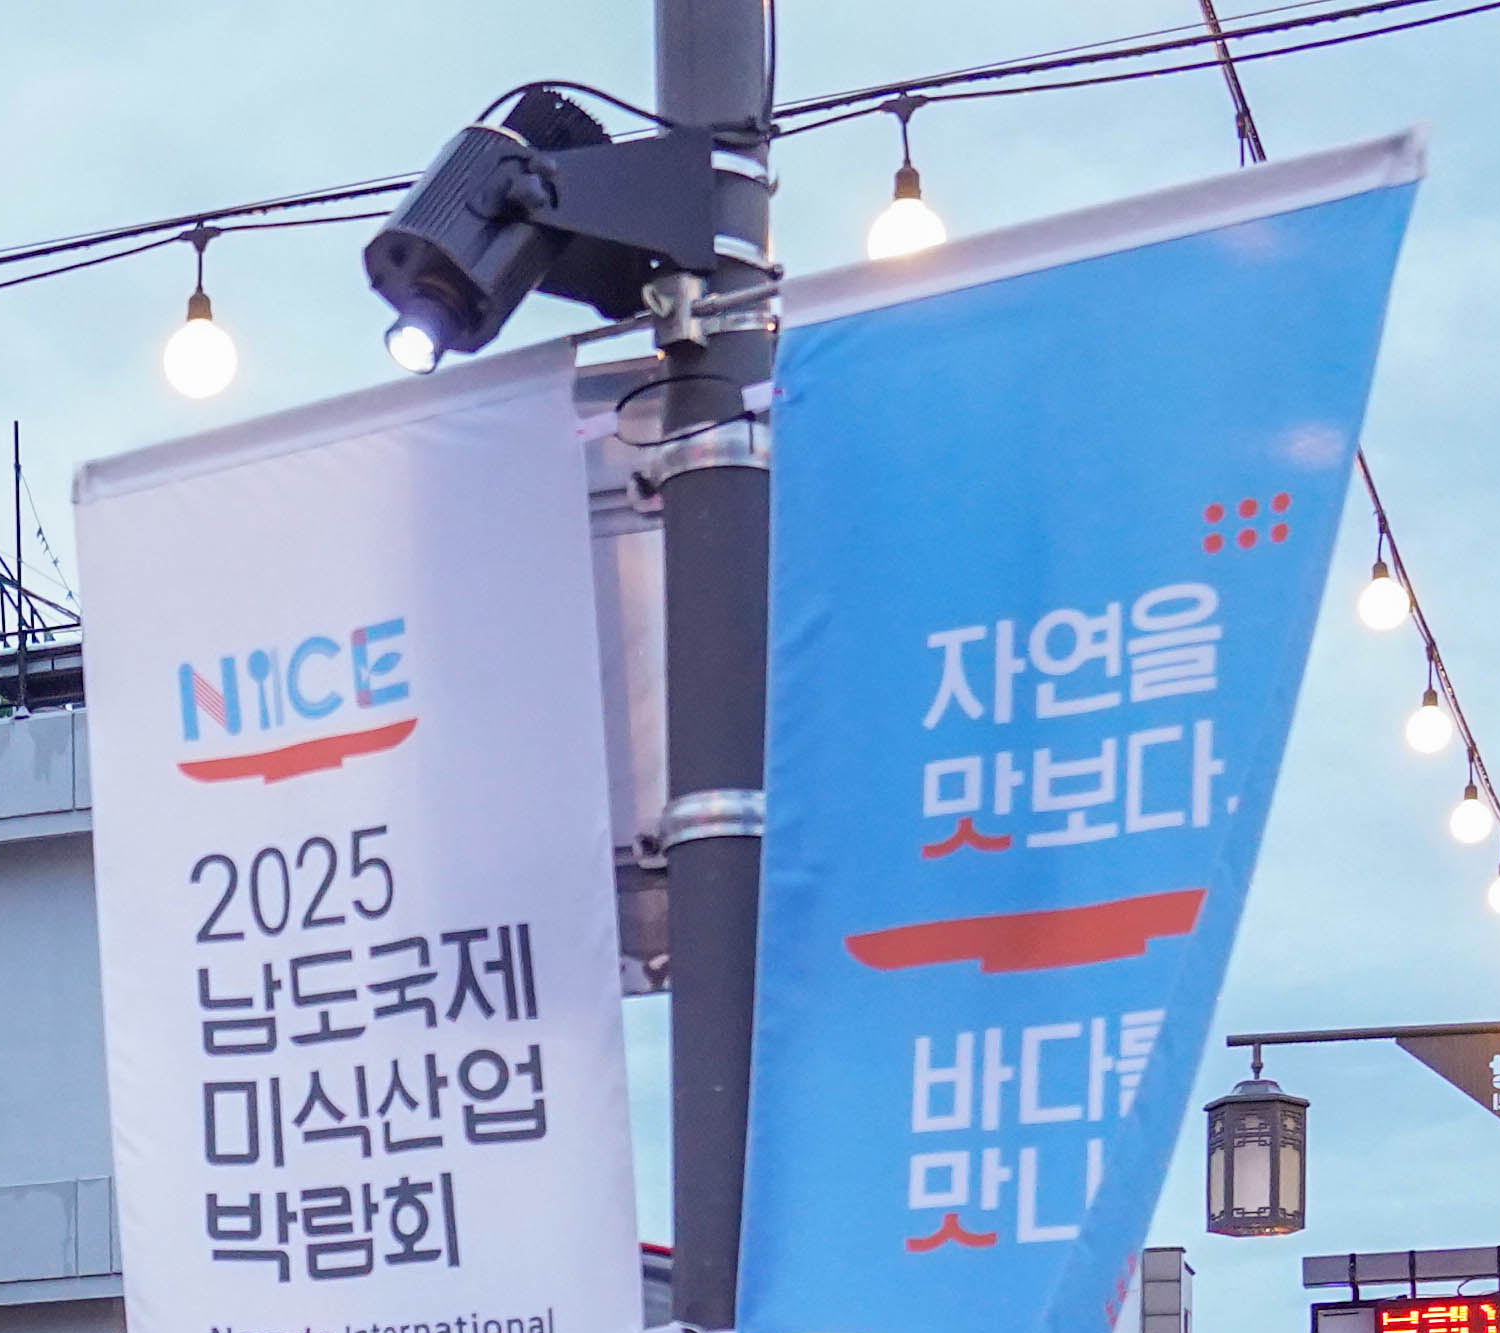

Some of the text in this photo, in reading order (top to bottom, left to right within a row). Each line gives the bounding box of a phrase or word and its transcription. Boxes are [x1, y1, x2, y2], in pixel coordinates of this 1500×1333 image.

[178, 617, 411, 742] NICE
[922, 583, 1222, 731] 자연을
[190, 825, 394, 943] 2025
[198, 923, 538, 1057] 남도국제
[203, 1044, 547, 1168] 미식산업
[206, 1172, 460, 1282] 박람회
